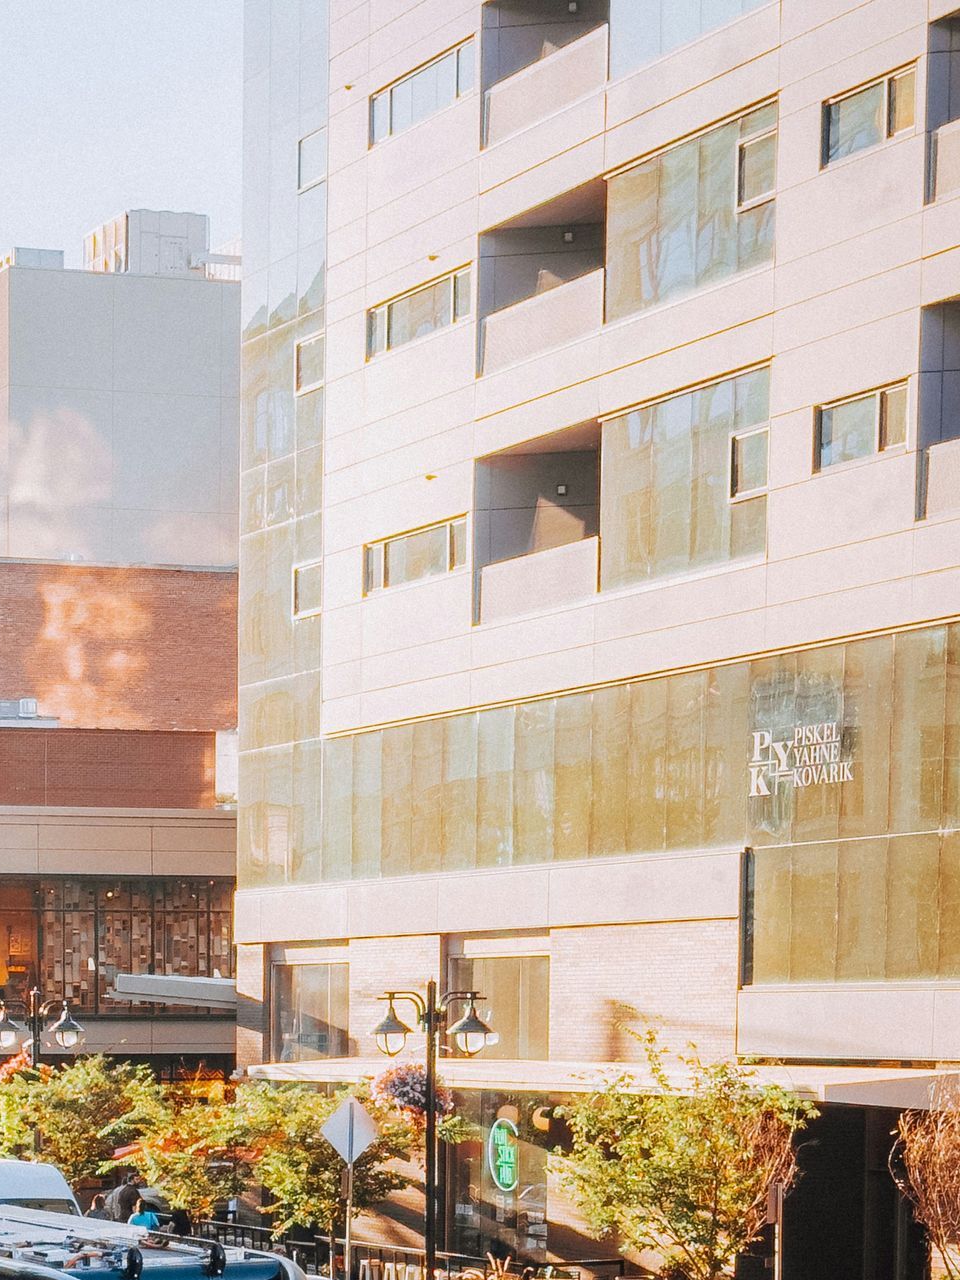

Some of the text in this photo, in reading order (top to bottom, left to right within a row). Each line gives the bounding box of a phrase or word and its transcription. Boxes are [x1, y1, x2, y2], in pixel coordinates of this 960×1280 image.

[794, 723, 840, 746] PISKEL
[794, 742, 840, 767] YAHNE
[793, 761, 853, 788] KOVARIK
